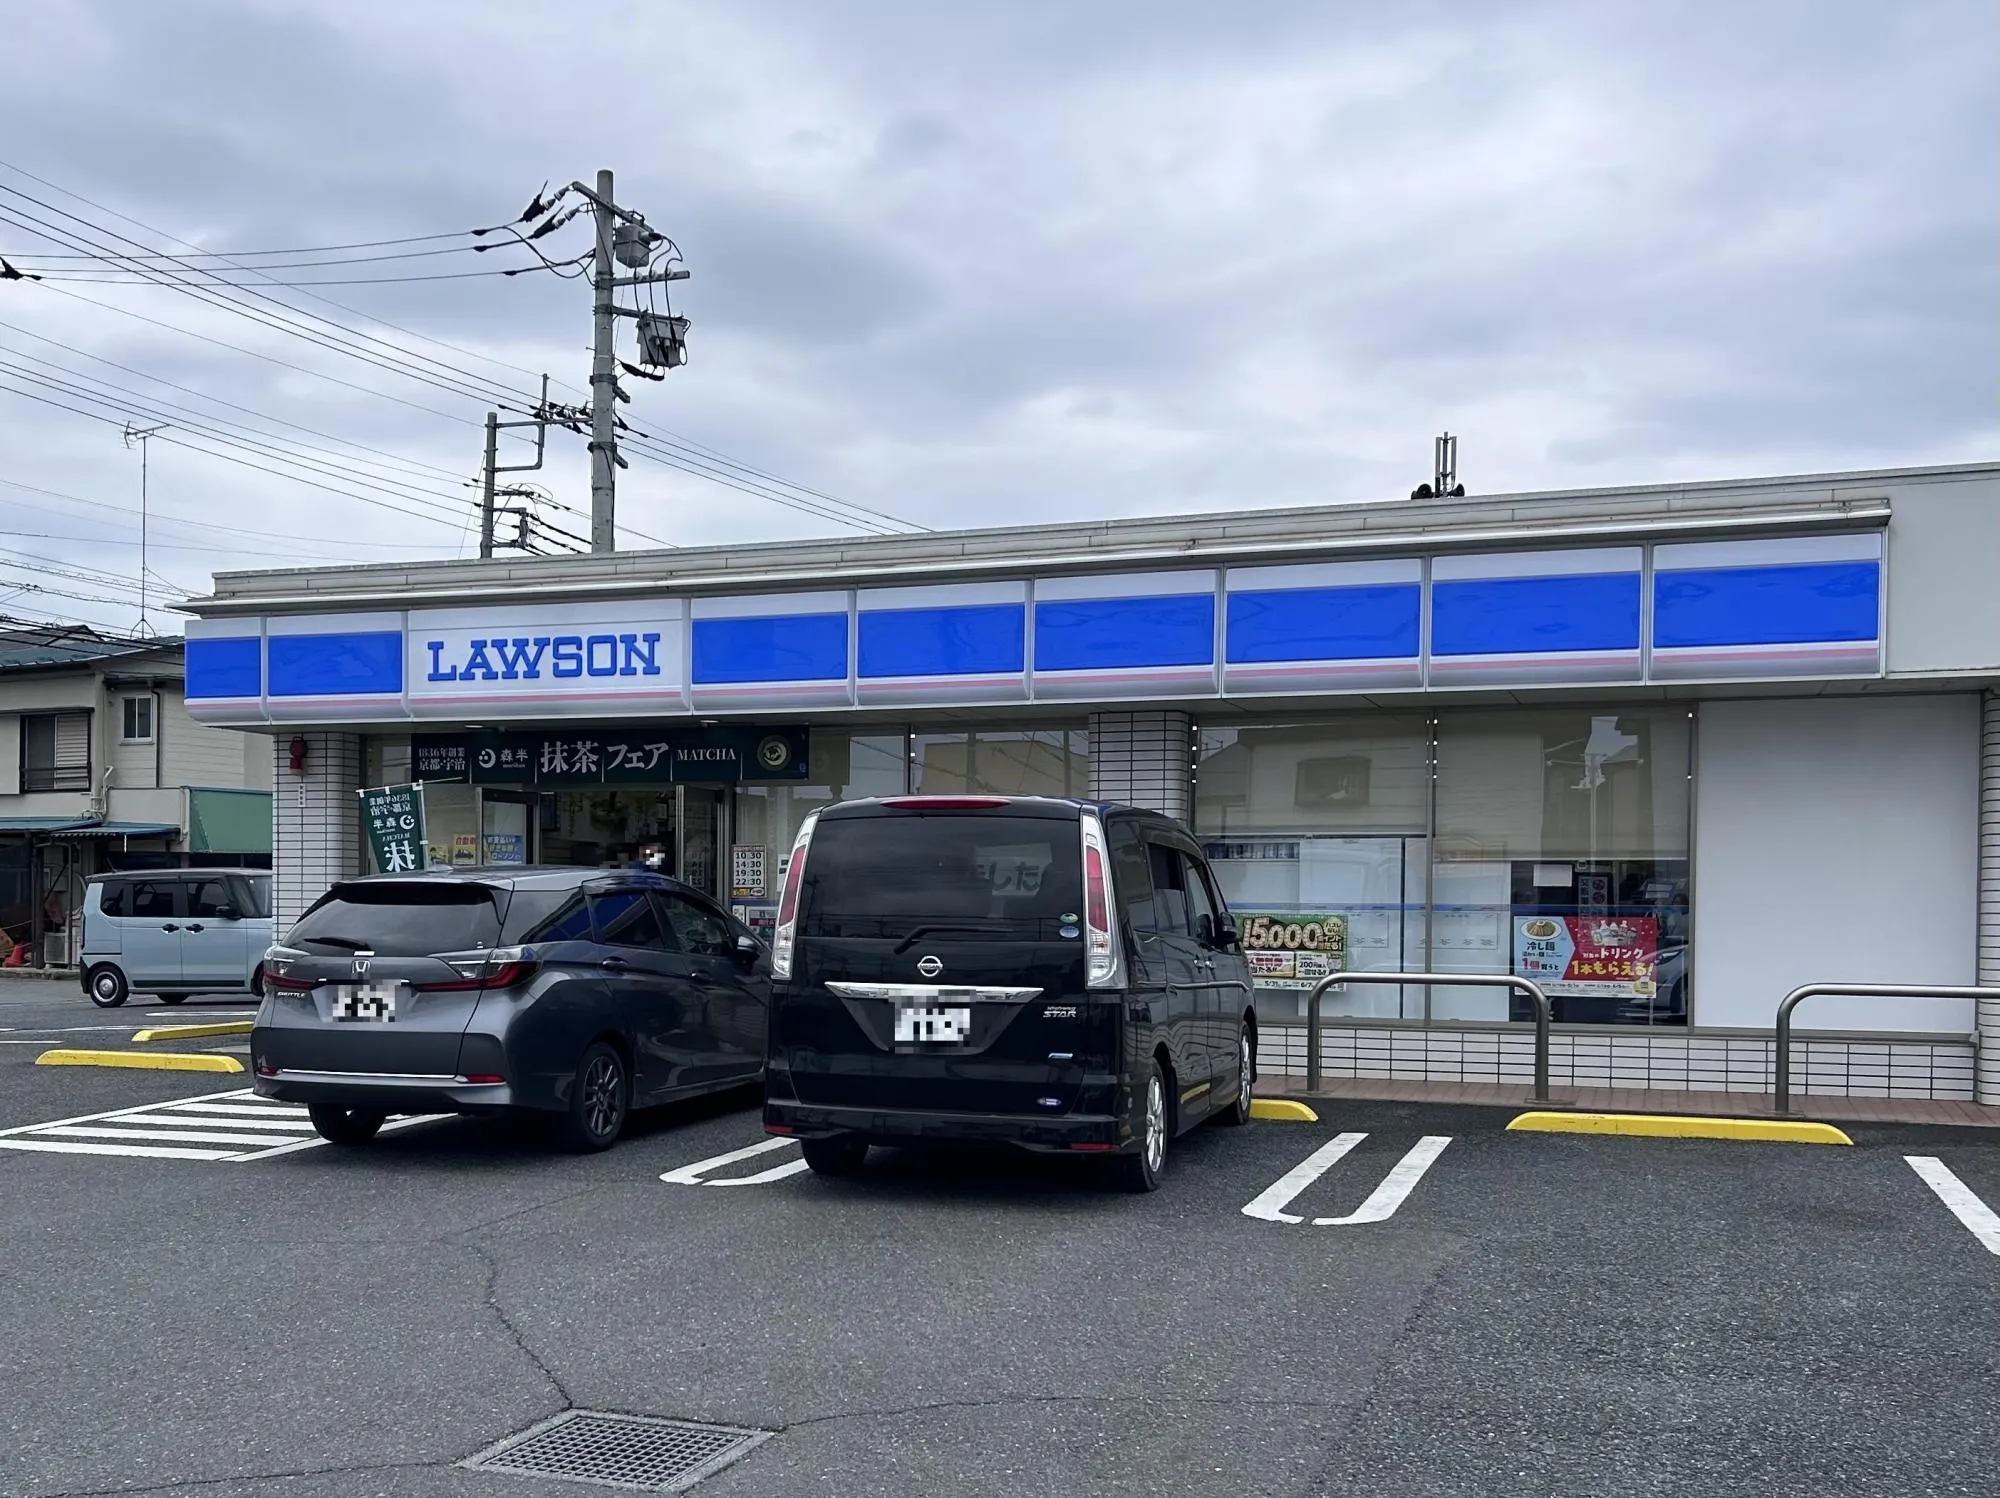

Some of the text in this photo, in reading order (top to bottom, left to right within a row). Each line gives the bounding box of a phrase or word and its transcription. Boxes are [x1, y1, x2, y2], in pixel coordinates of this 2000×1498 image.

[427, 633, 661, 682] LAWSON
[500, 748, 529, 762] 森半
[540, 741, 669, 774] 抹茶フェア
[677, 748, 736, 761] MATCHA
[735, 852, 762, 860] 10:30
[735, 869, 762, 877] 19:30
[735, 878, 762, 886] 22:30
